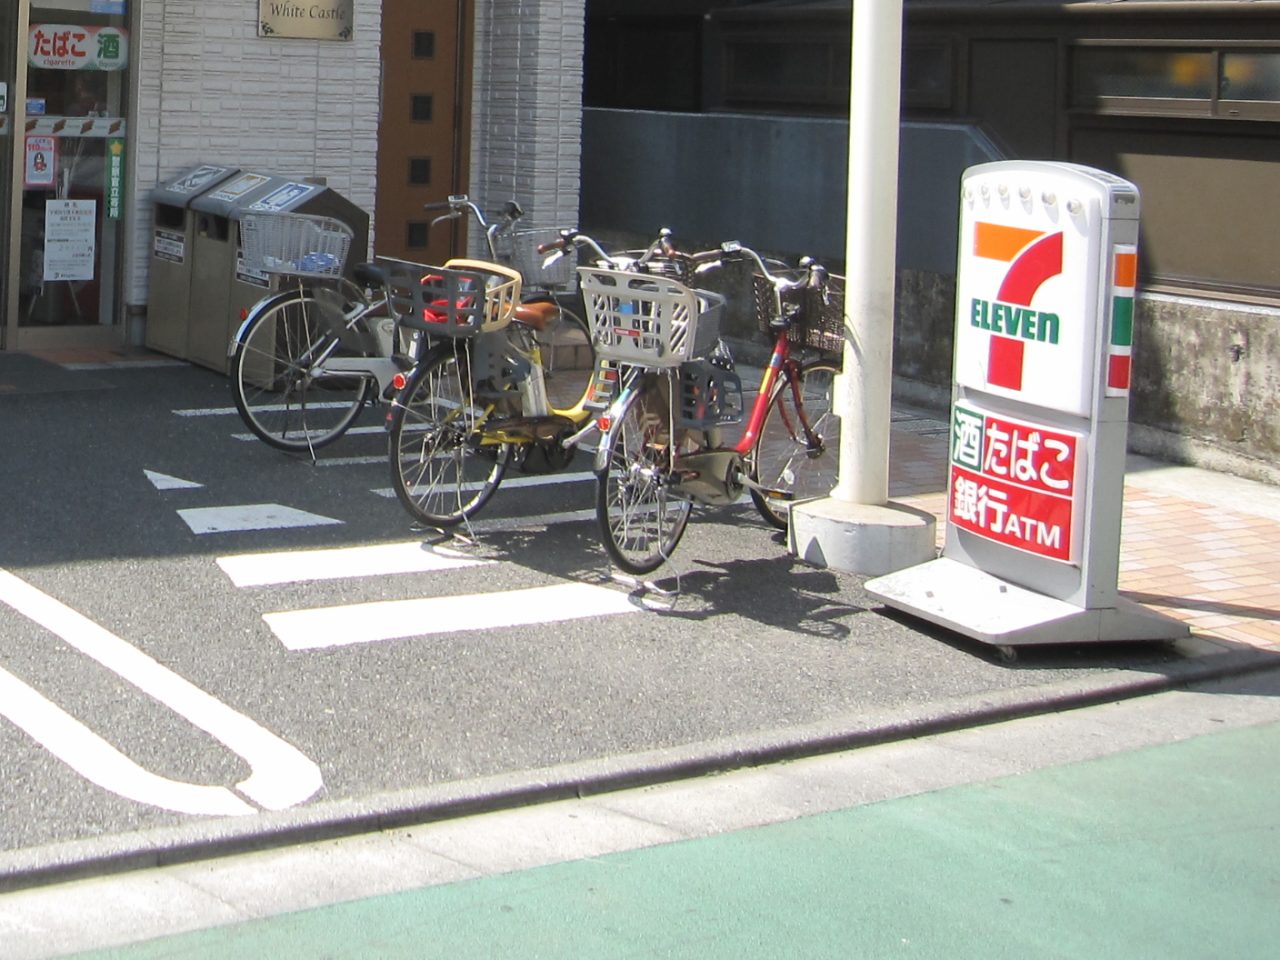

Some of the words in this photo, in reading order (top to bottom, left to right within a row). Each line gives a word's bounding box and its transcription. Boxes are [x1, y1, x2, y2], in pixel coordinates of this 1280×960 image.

[270, 0, 306, 19] White
[309, 4, 346, 21] Castle
[33, 29, 87, 58] たばこ
[97, 33, 120, 59] 酒
[952, 410, 983, 468] 酒
[984, 423, 1071, 491] たばこ
